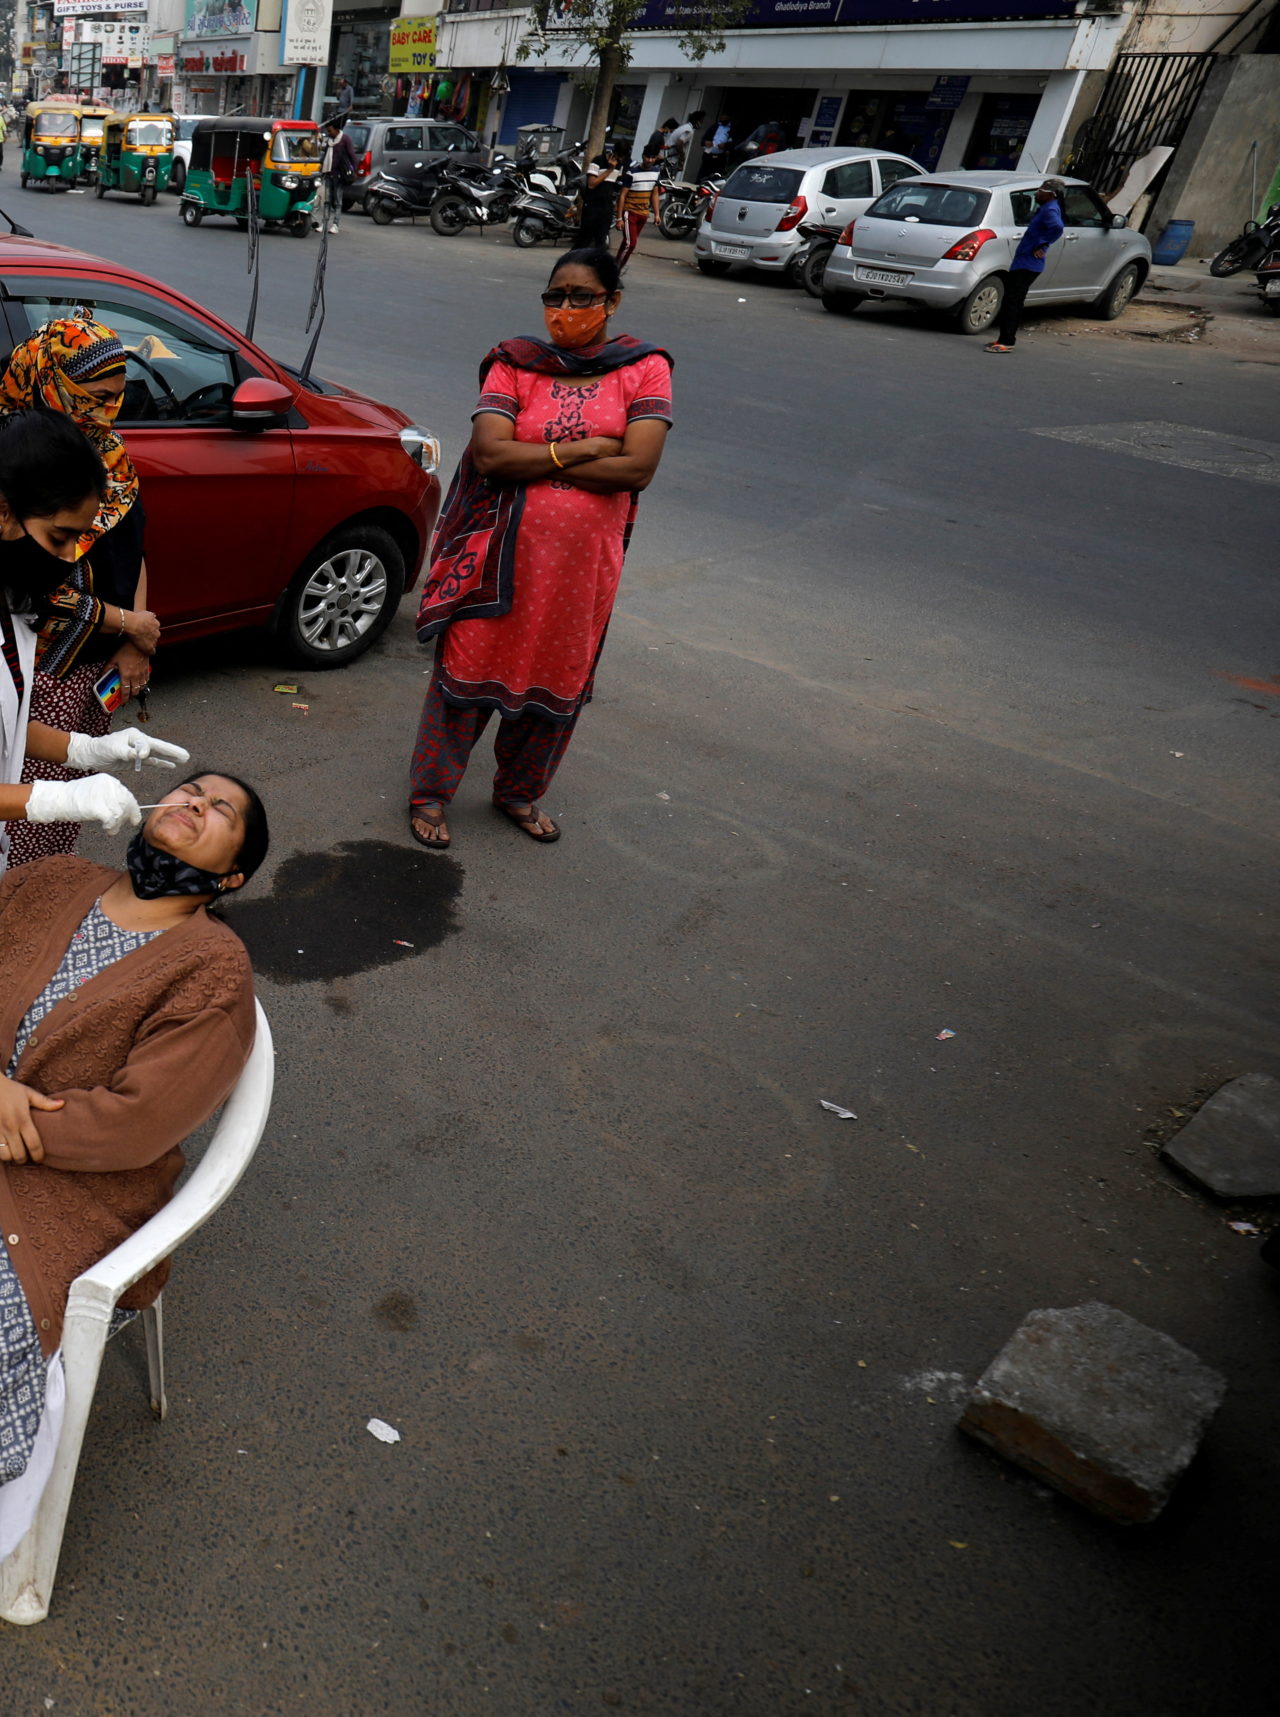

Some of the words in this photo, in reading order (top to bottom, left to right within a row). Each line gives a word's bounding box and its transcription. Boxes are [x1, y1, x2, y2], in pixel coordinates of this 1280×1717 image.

[114, 1, 145, 9] PURSE
[774, 1, 808, 12] Ghatlodiya
[808, 0, 831, 10] Branch
[391, 31, 411, 46] BABY
[412, 29, 433, 44] CARE
[412, 52, 428, 66] TOY
